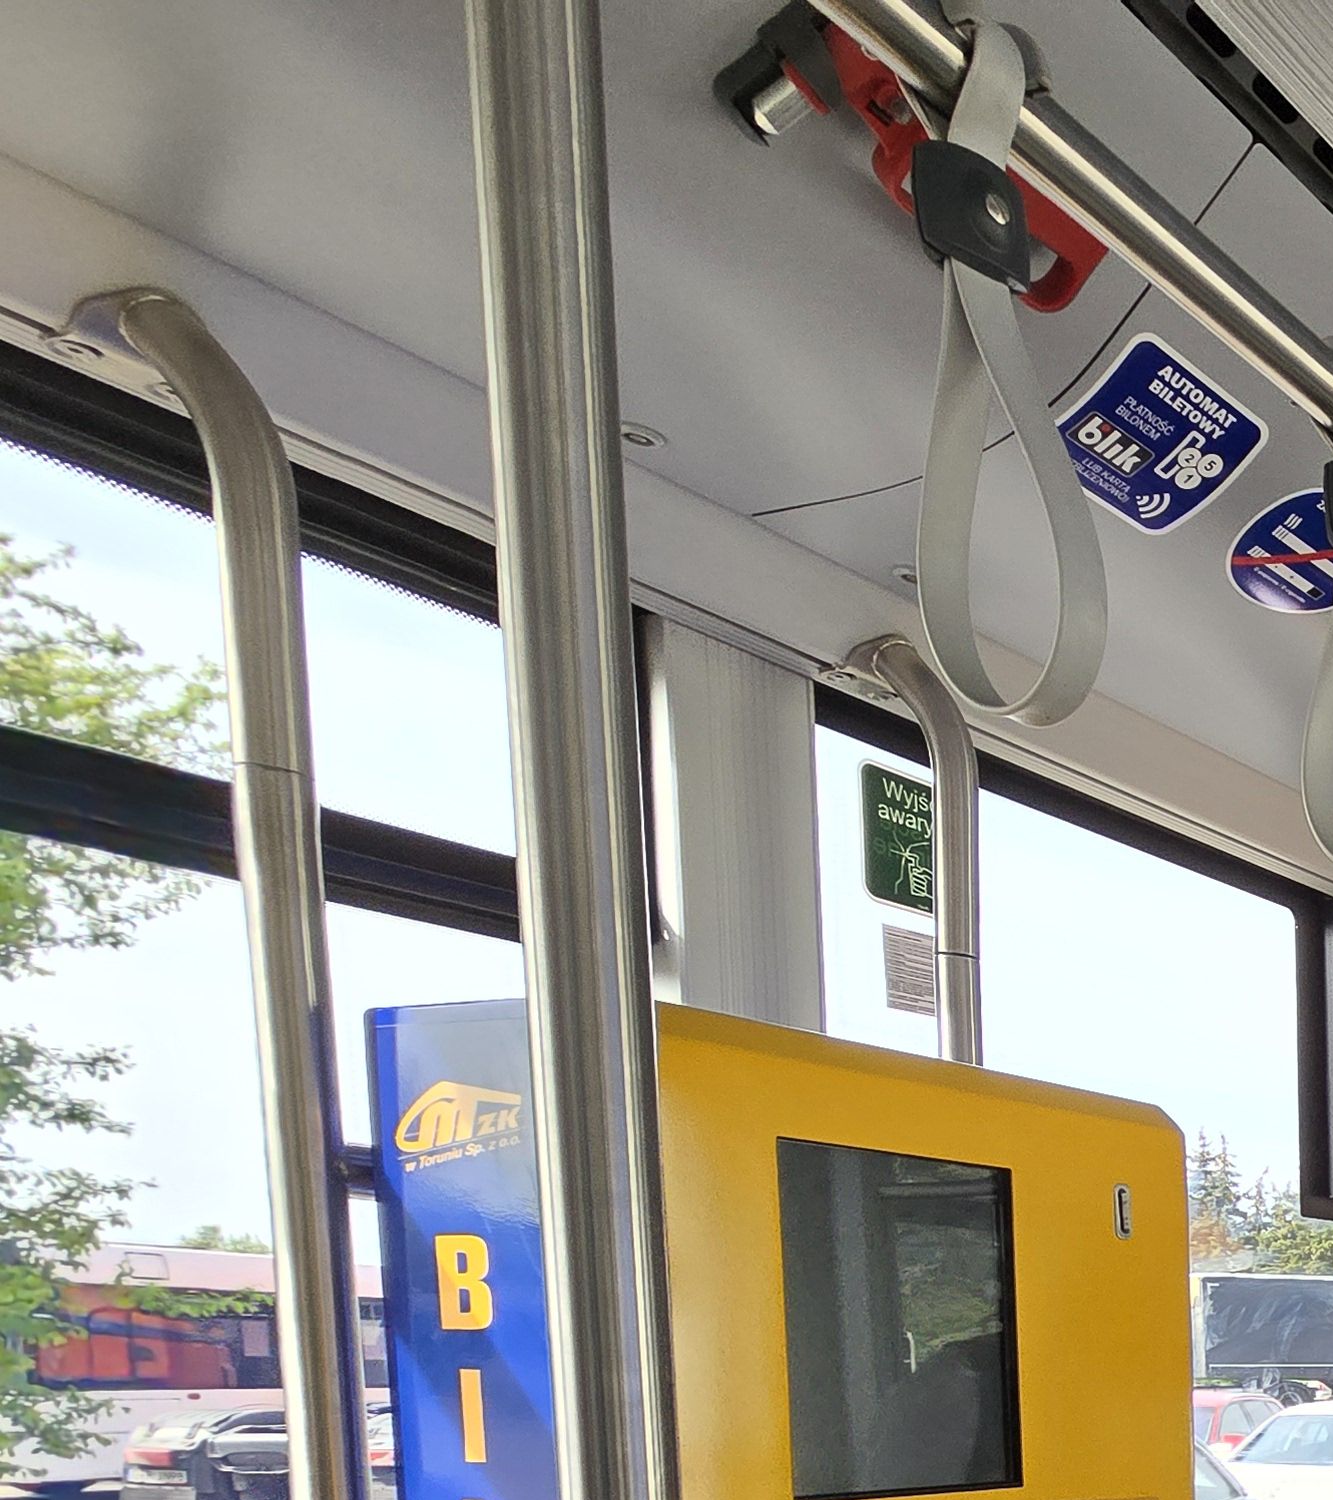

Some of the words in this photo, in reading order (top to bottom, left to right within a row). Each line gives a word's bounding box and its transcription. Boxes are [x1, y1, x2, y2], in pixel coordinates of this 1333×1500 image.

[1149, 379, 1226, 440] BILETOWY
[1157, 365, 1237, 429] AUTOMAT
[1115, 405, 1161, 441] BILONEM
[1123, 396, 1176, 437] PŁATNOŚĆ
[1077, 416, 1142, 473] blik
[1081, 457, 1103, 474] LUB
[881, 777, 934, 813] Wyjś
[877, 803, 934, 838] awary
